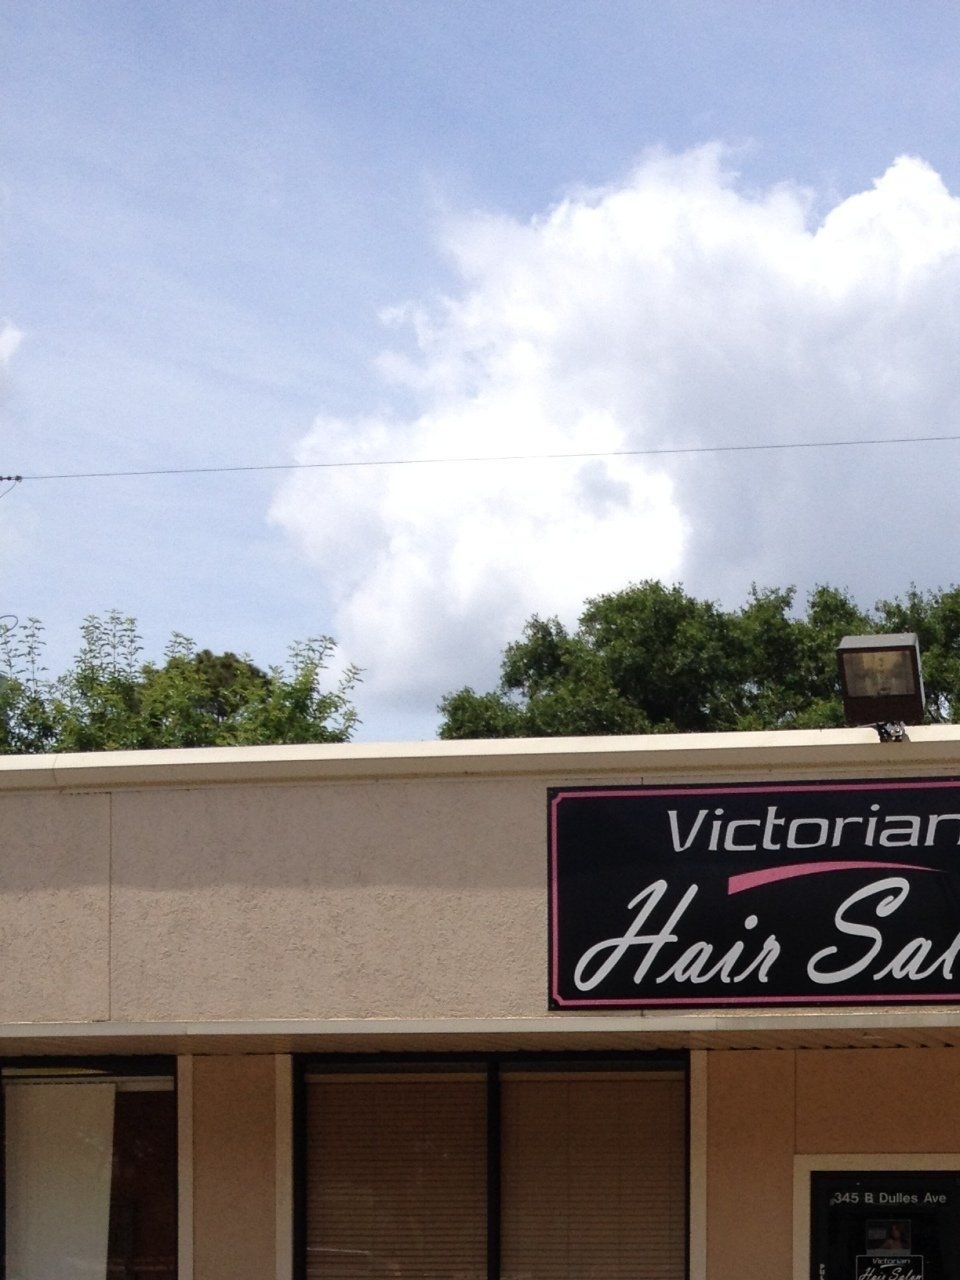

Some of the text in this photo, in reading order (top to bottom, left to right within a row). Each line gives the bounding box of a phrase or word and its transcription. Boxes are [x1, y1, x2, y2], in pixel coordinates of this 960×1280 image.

[574, 878, 782, 992] Hair
[834, 1192, 947, 1204] 345 B Dulles Ave
